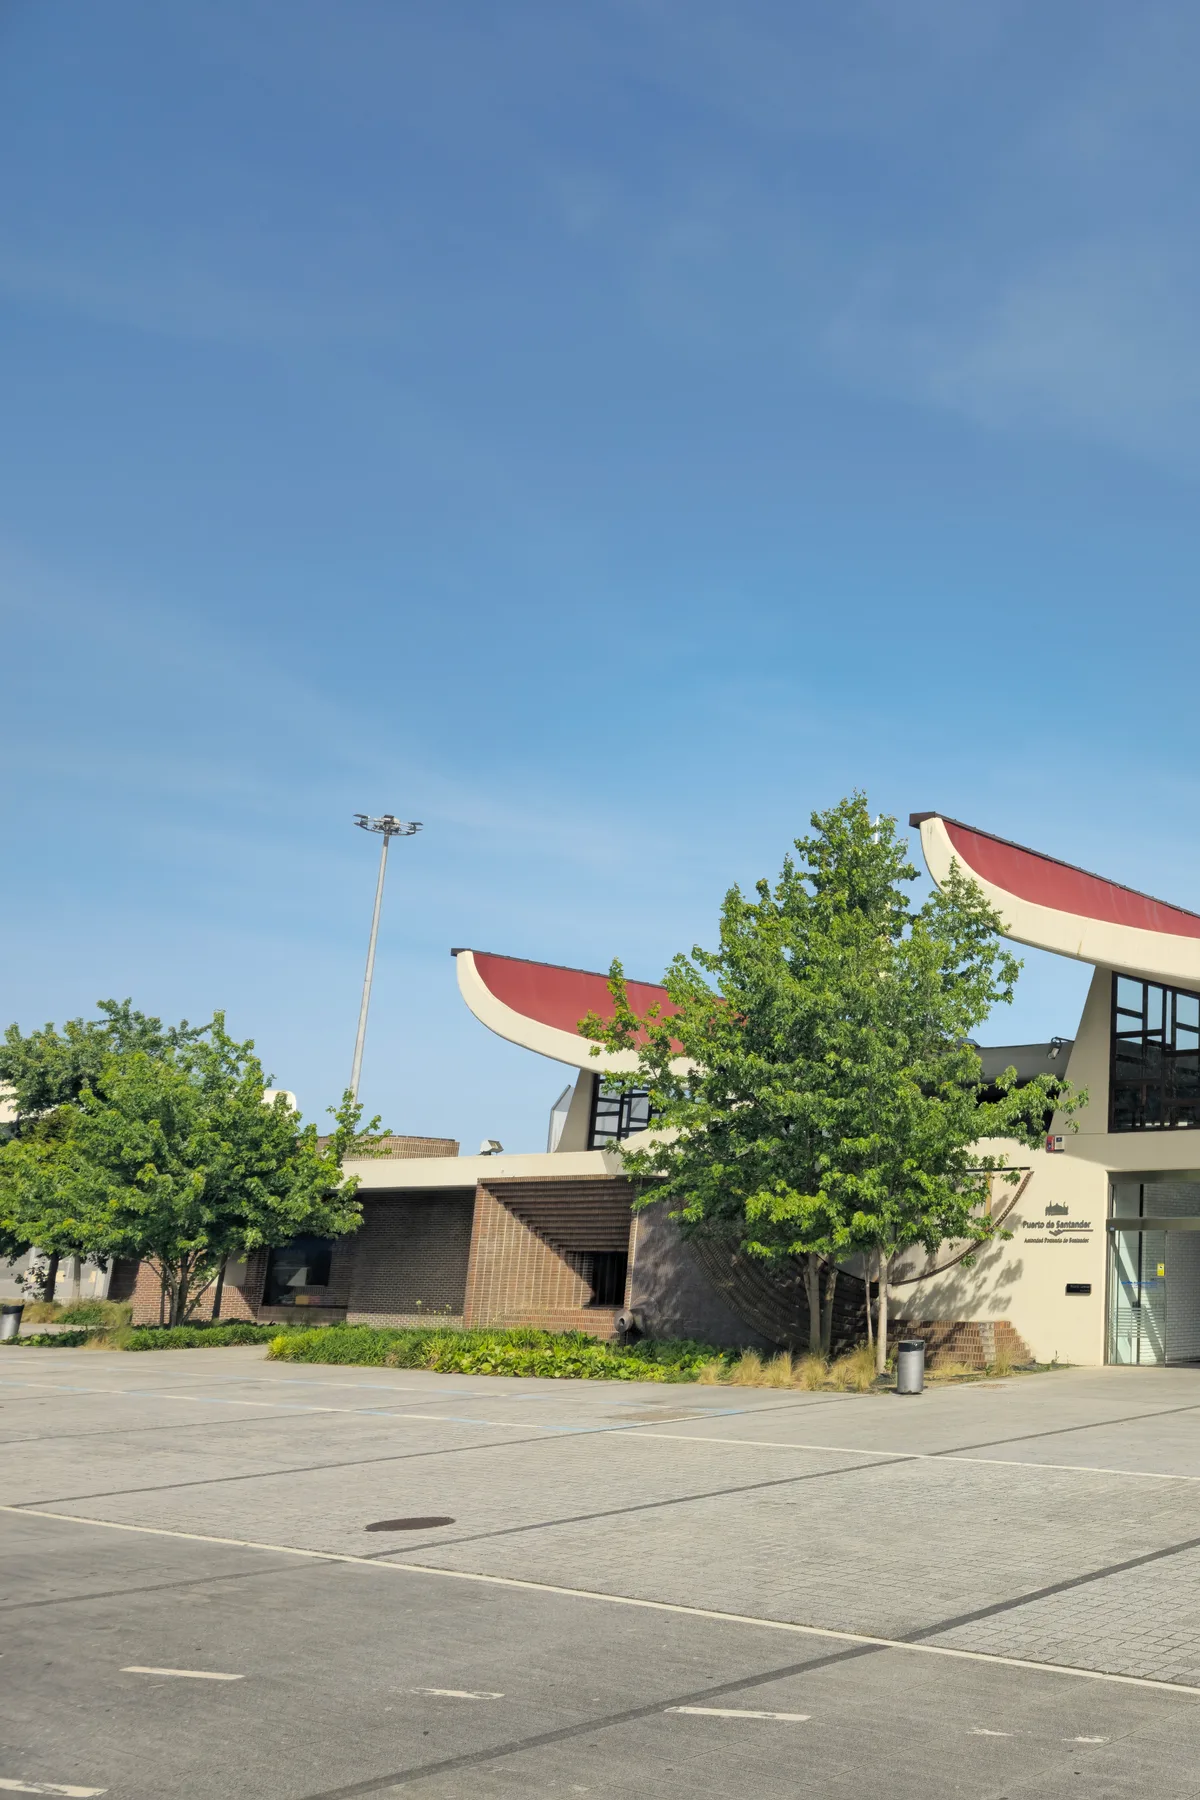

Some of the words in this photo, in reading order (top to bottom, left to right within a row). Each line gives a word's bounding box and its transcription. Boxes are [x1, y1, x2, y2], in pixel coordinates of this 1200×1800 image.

[1022, 1220, 1044, 1229] Puerto
[1046, 1220, 1055, 1229] de
[1056, 1220, 1091, 1229] Santander
